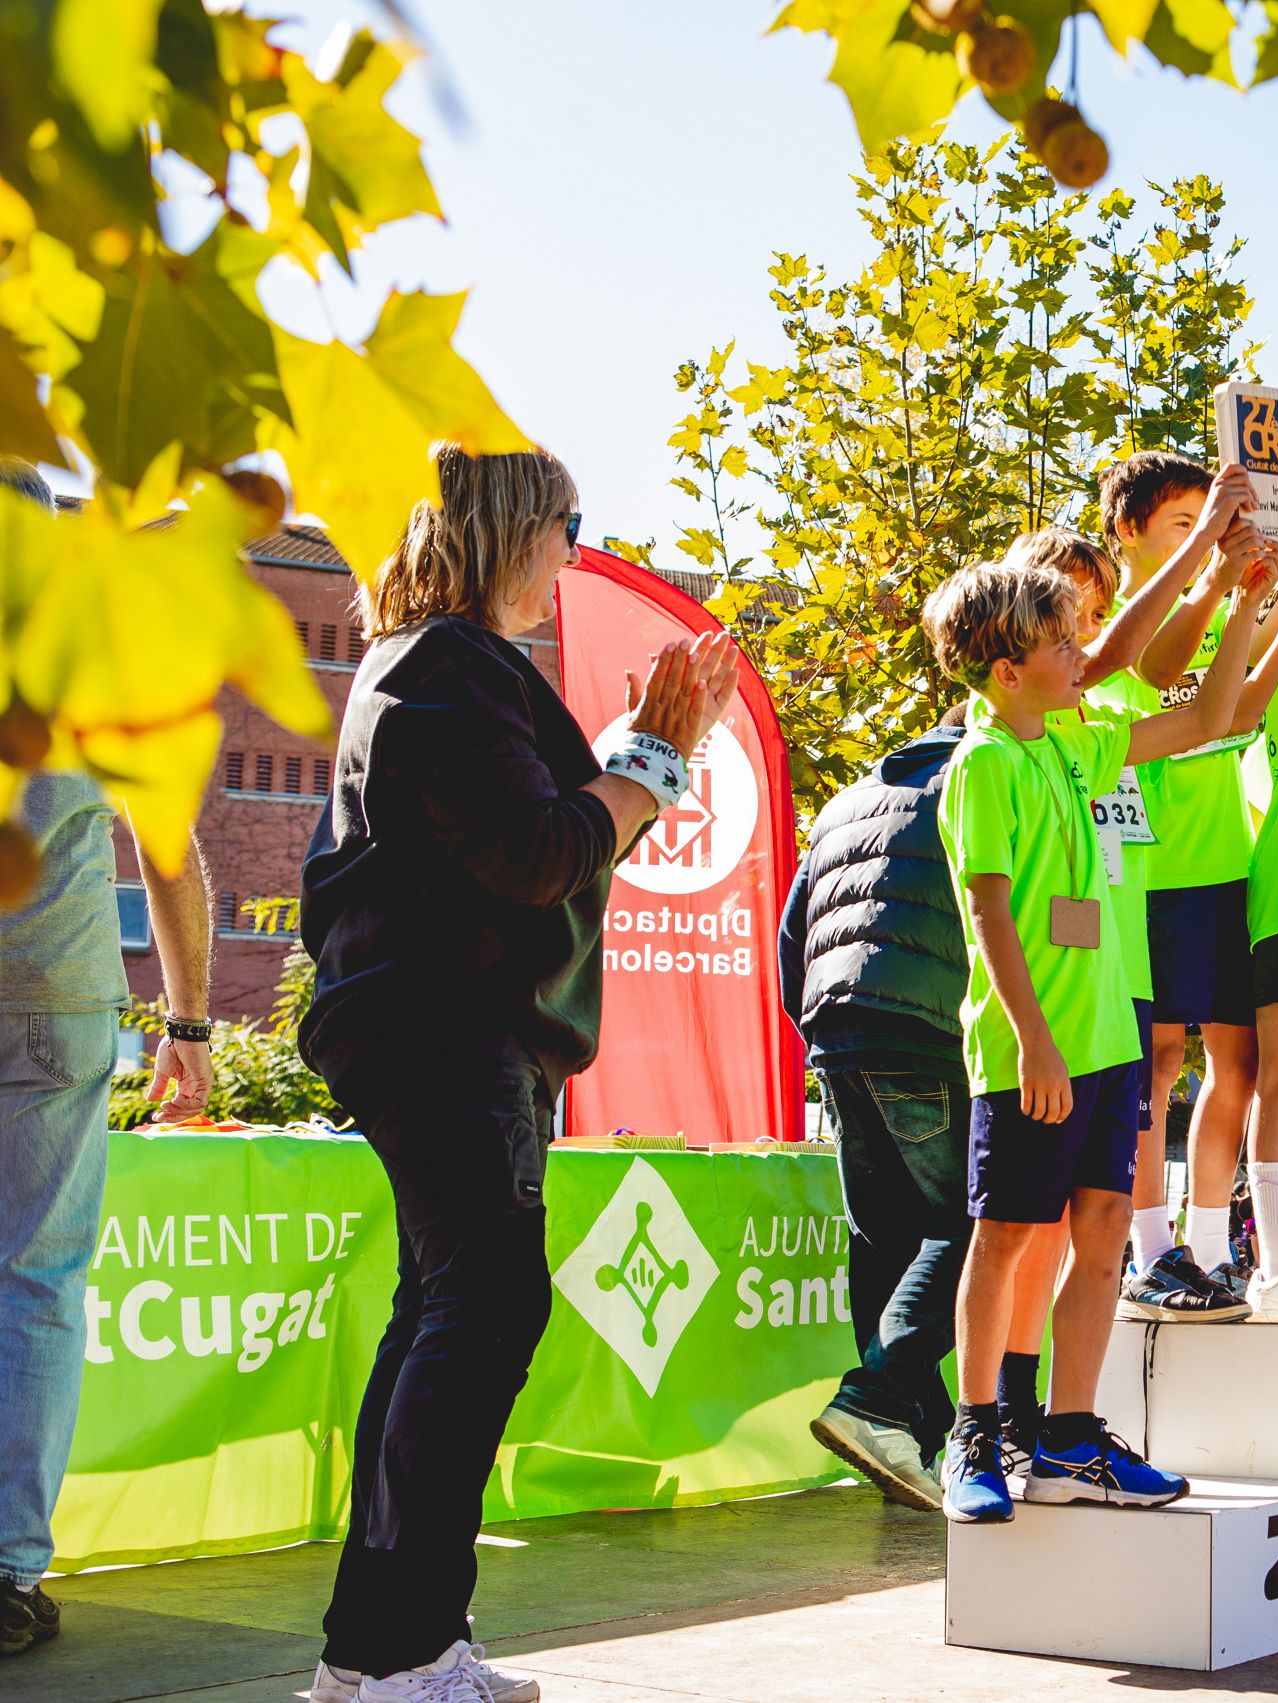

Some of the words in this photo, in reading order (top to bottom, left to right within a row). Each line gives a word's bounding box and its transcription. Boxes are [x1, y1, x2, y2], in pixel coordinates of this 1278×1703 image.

[639, 737, 678, 760] OMET
[93, 1212, 288, 1270] AMENT
[304, 1212, 363, 1261] DE
[739, 1215, 849, 1257] AJUNT
[84, 1272, 337, 1373] tCugat
[734, 1265, 851, 1329] Sant
